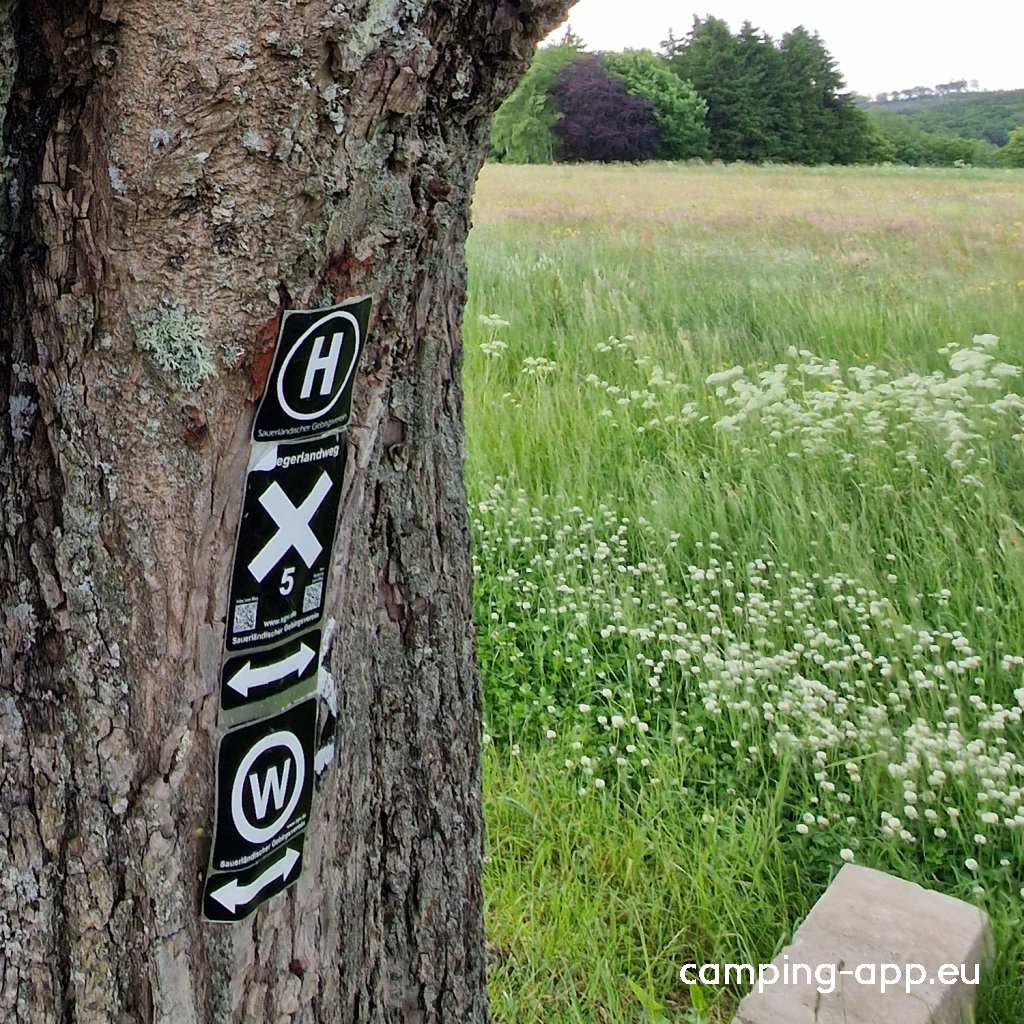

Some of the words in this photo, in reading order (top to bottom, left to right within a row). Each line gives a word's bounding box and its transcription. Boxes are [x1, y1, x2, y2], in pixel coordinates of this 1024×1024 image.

[300, 332, 344, 399] H
[276, 445, 339, 468] egerlandweg
[279, 567, 296, 595] 5
[249, 757, 291, 820] W
